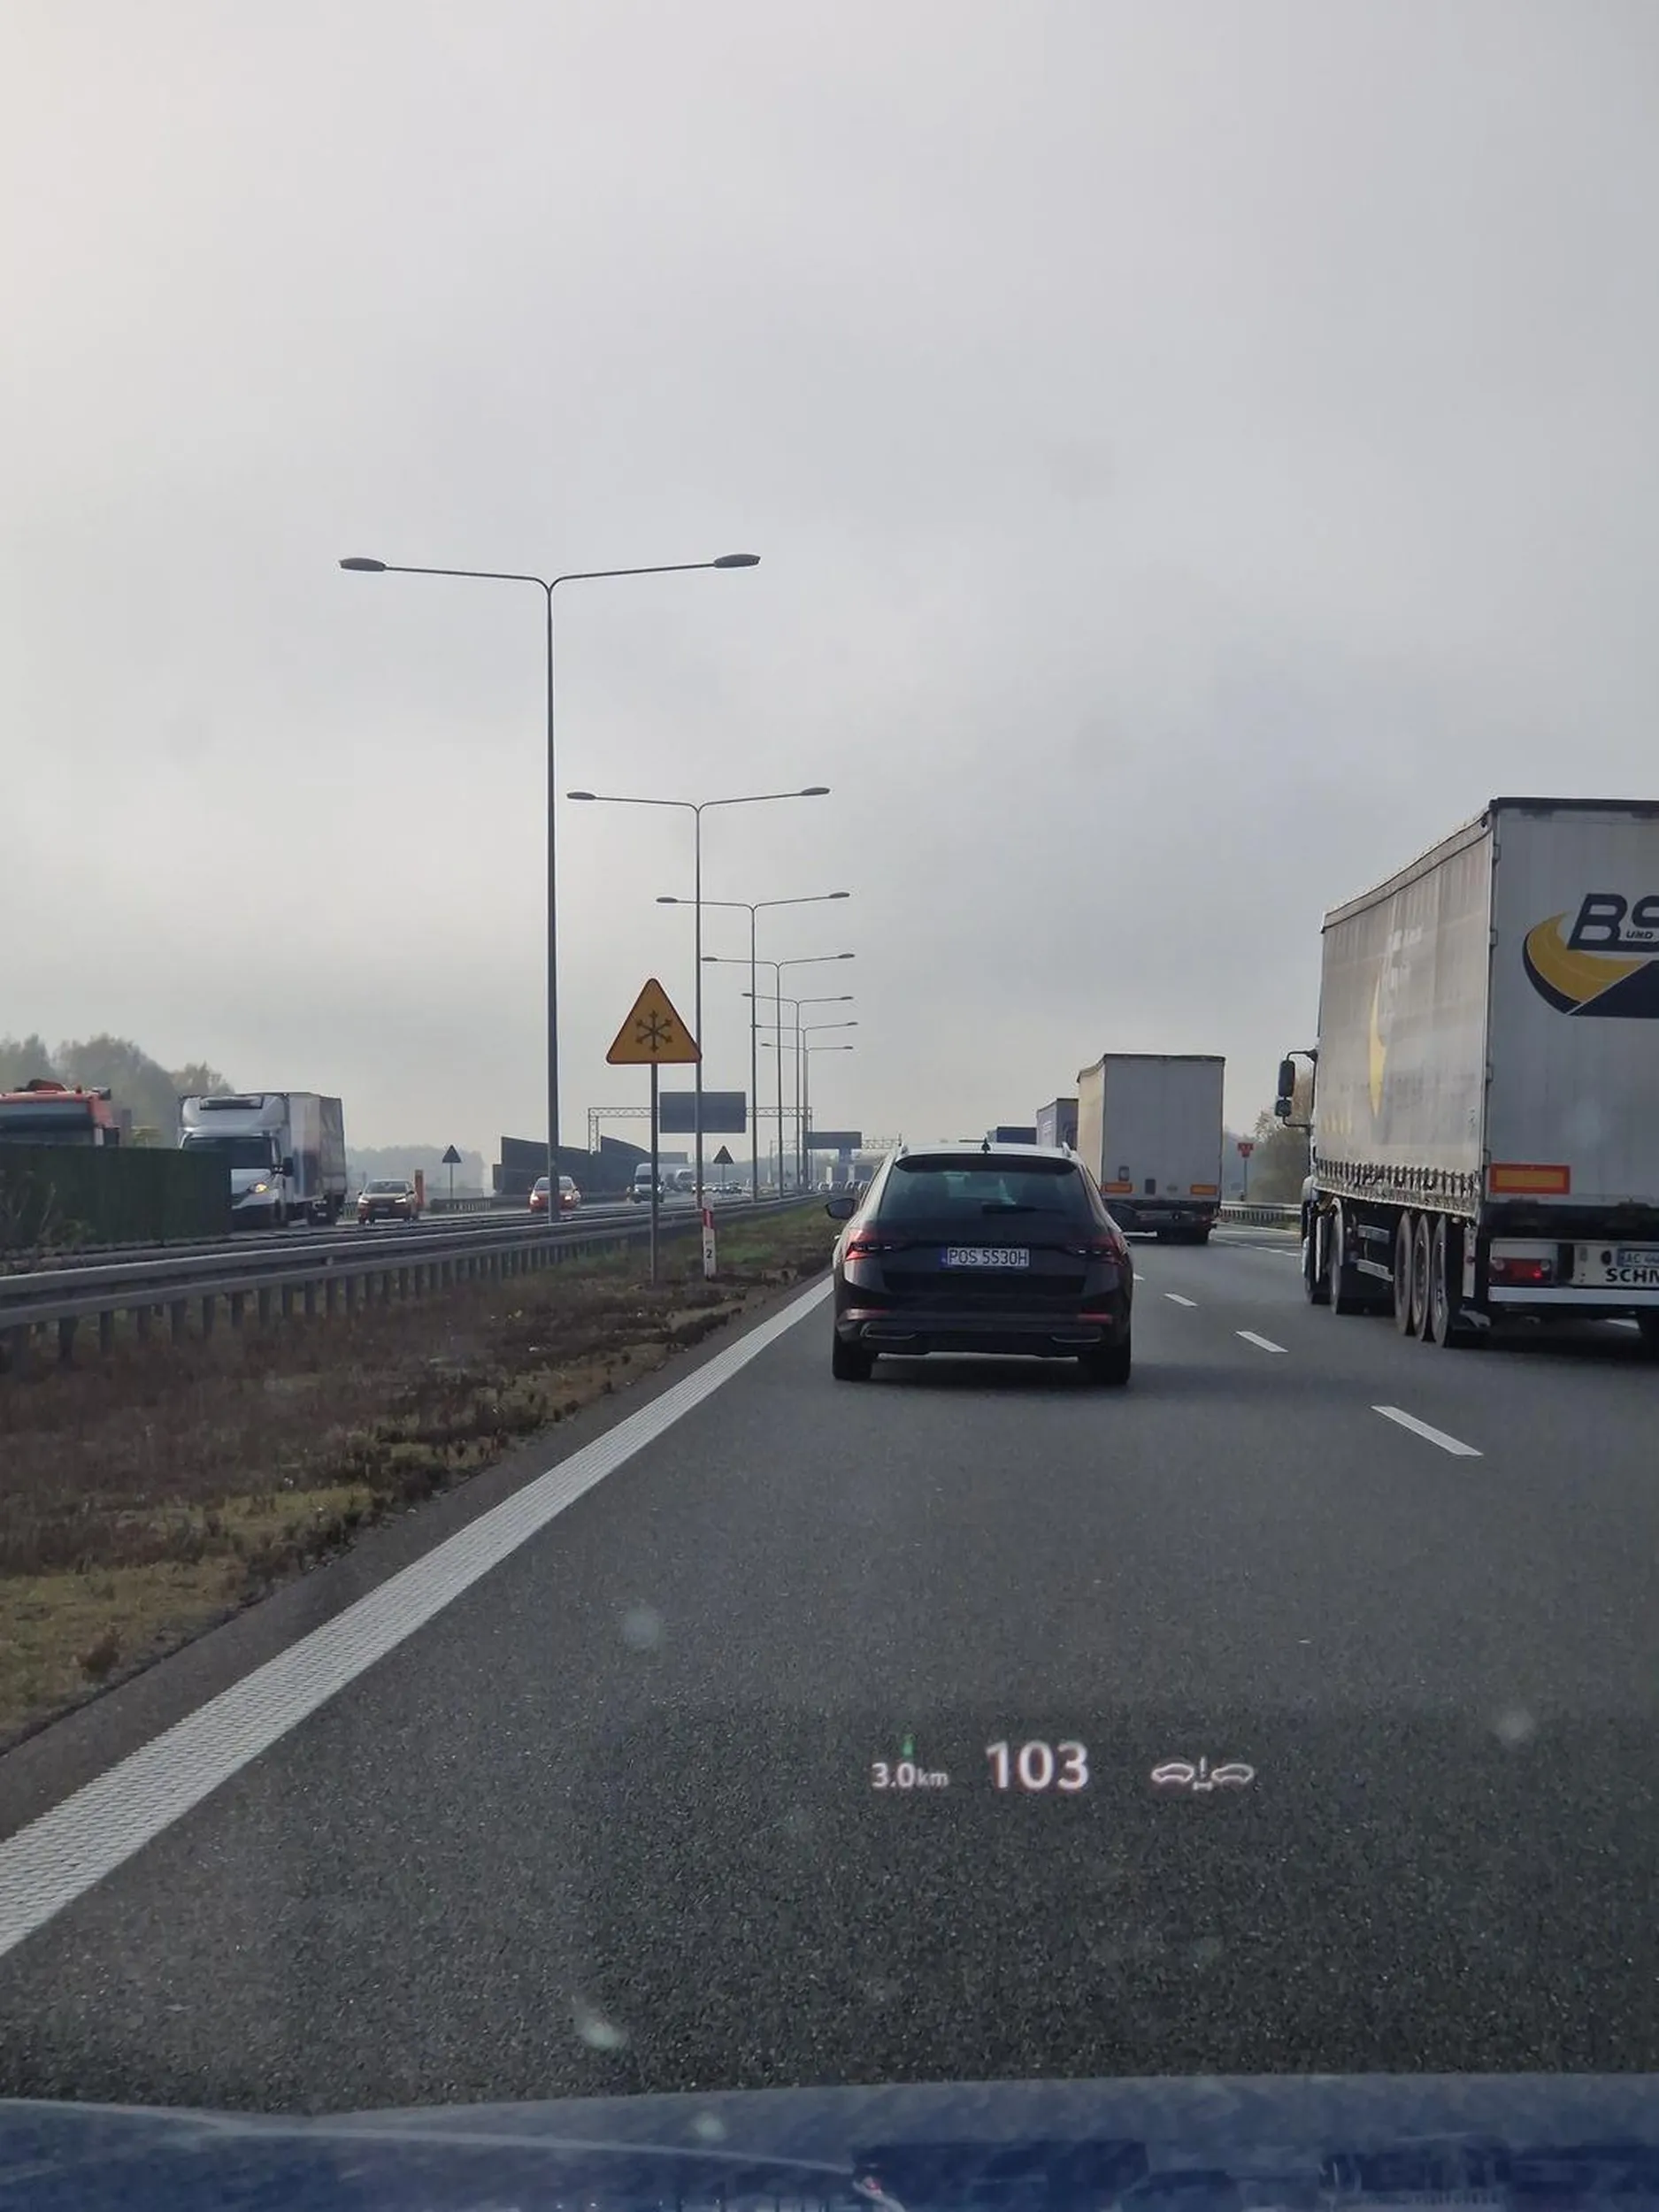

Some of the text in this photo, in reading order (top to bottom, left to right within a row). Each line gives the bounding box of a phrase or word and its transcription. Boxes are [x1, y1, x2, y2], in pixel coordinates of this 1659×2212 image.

[706, 1248, 712, 1259] 2
[949, 1249, 1026, 1265] POS 5530H
[986, 1740, 1088, 1788] 103
